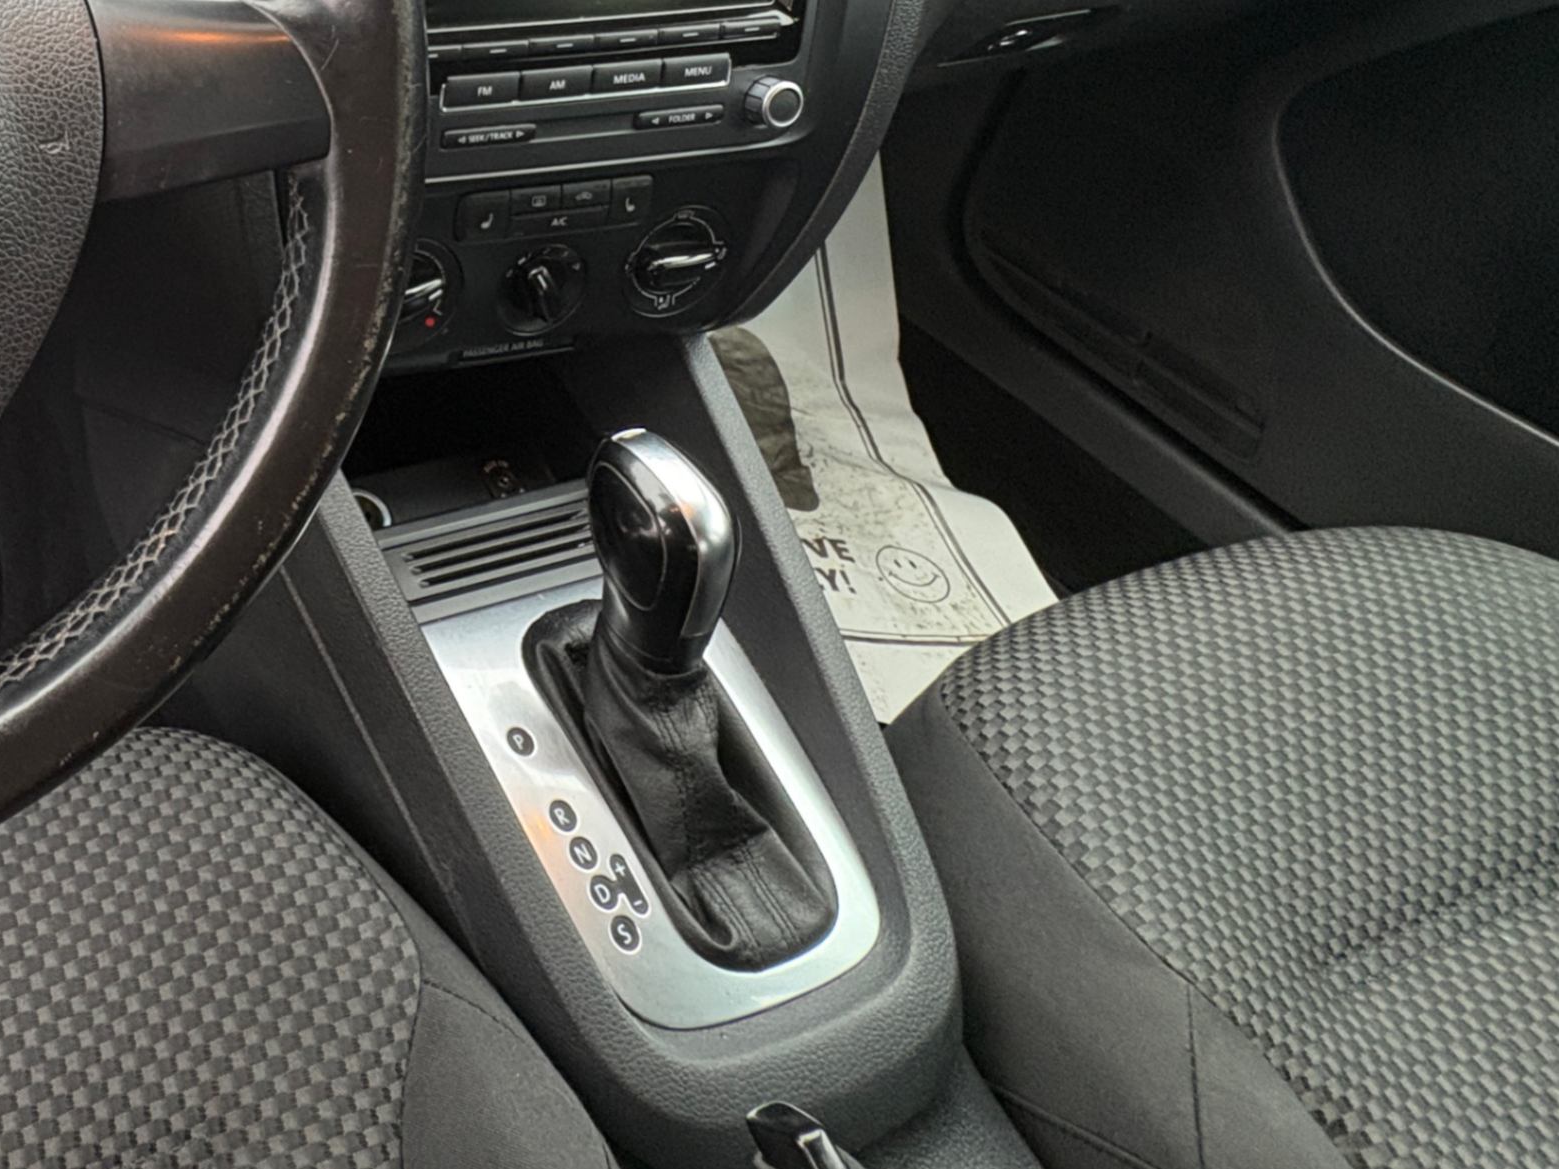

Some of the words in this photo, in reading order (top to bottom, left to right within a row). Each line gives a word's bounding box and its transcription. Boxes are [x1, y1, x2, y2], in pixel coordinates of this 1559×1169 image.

[613, 71, 646, 85] MEDIA
[684, 64, 713, 78] MENU
[477, 85, 493, 96] FM
[548, 80, 567, 91] AM
[668, 112, 697, 123] FOLDER
[551, 217, 568, 228] A/C
[513, 734, 524, 750] P
[553, 807, 569, 825] R
[574, 846, 591, 863] N
[595, 884, 610, 902] D
[617, 924, 631, 943] S
